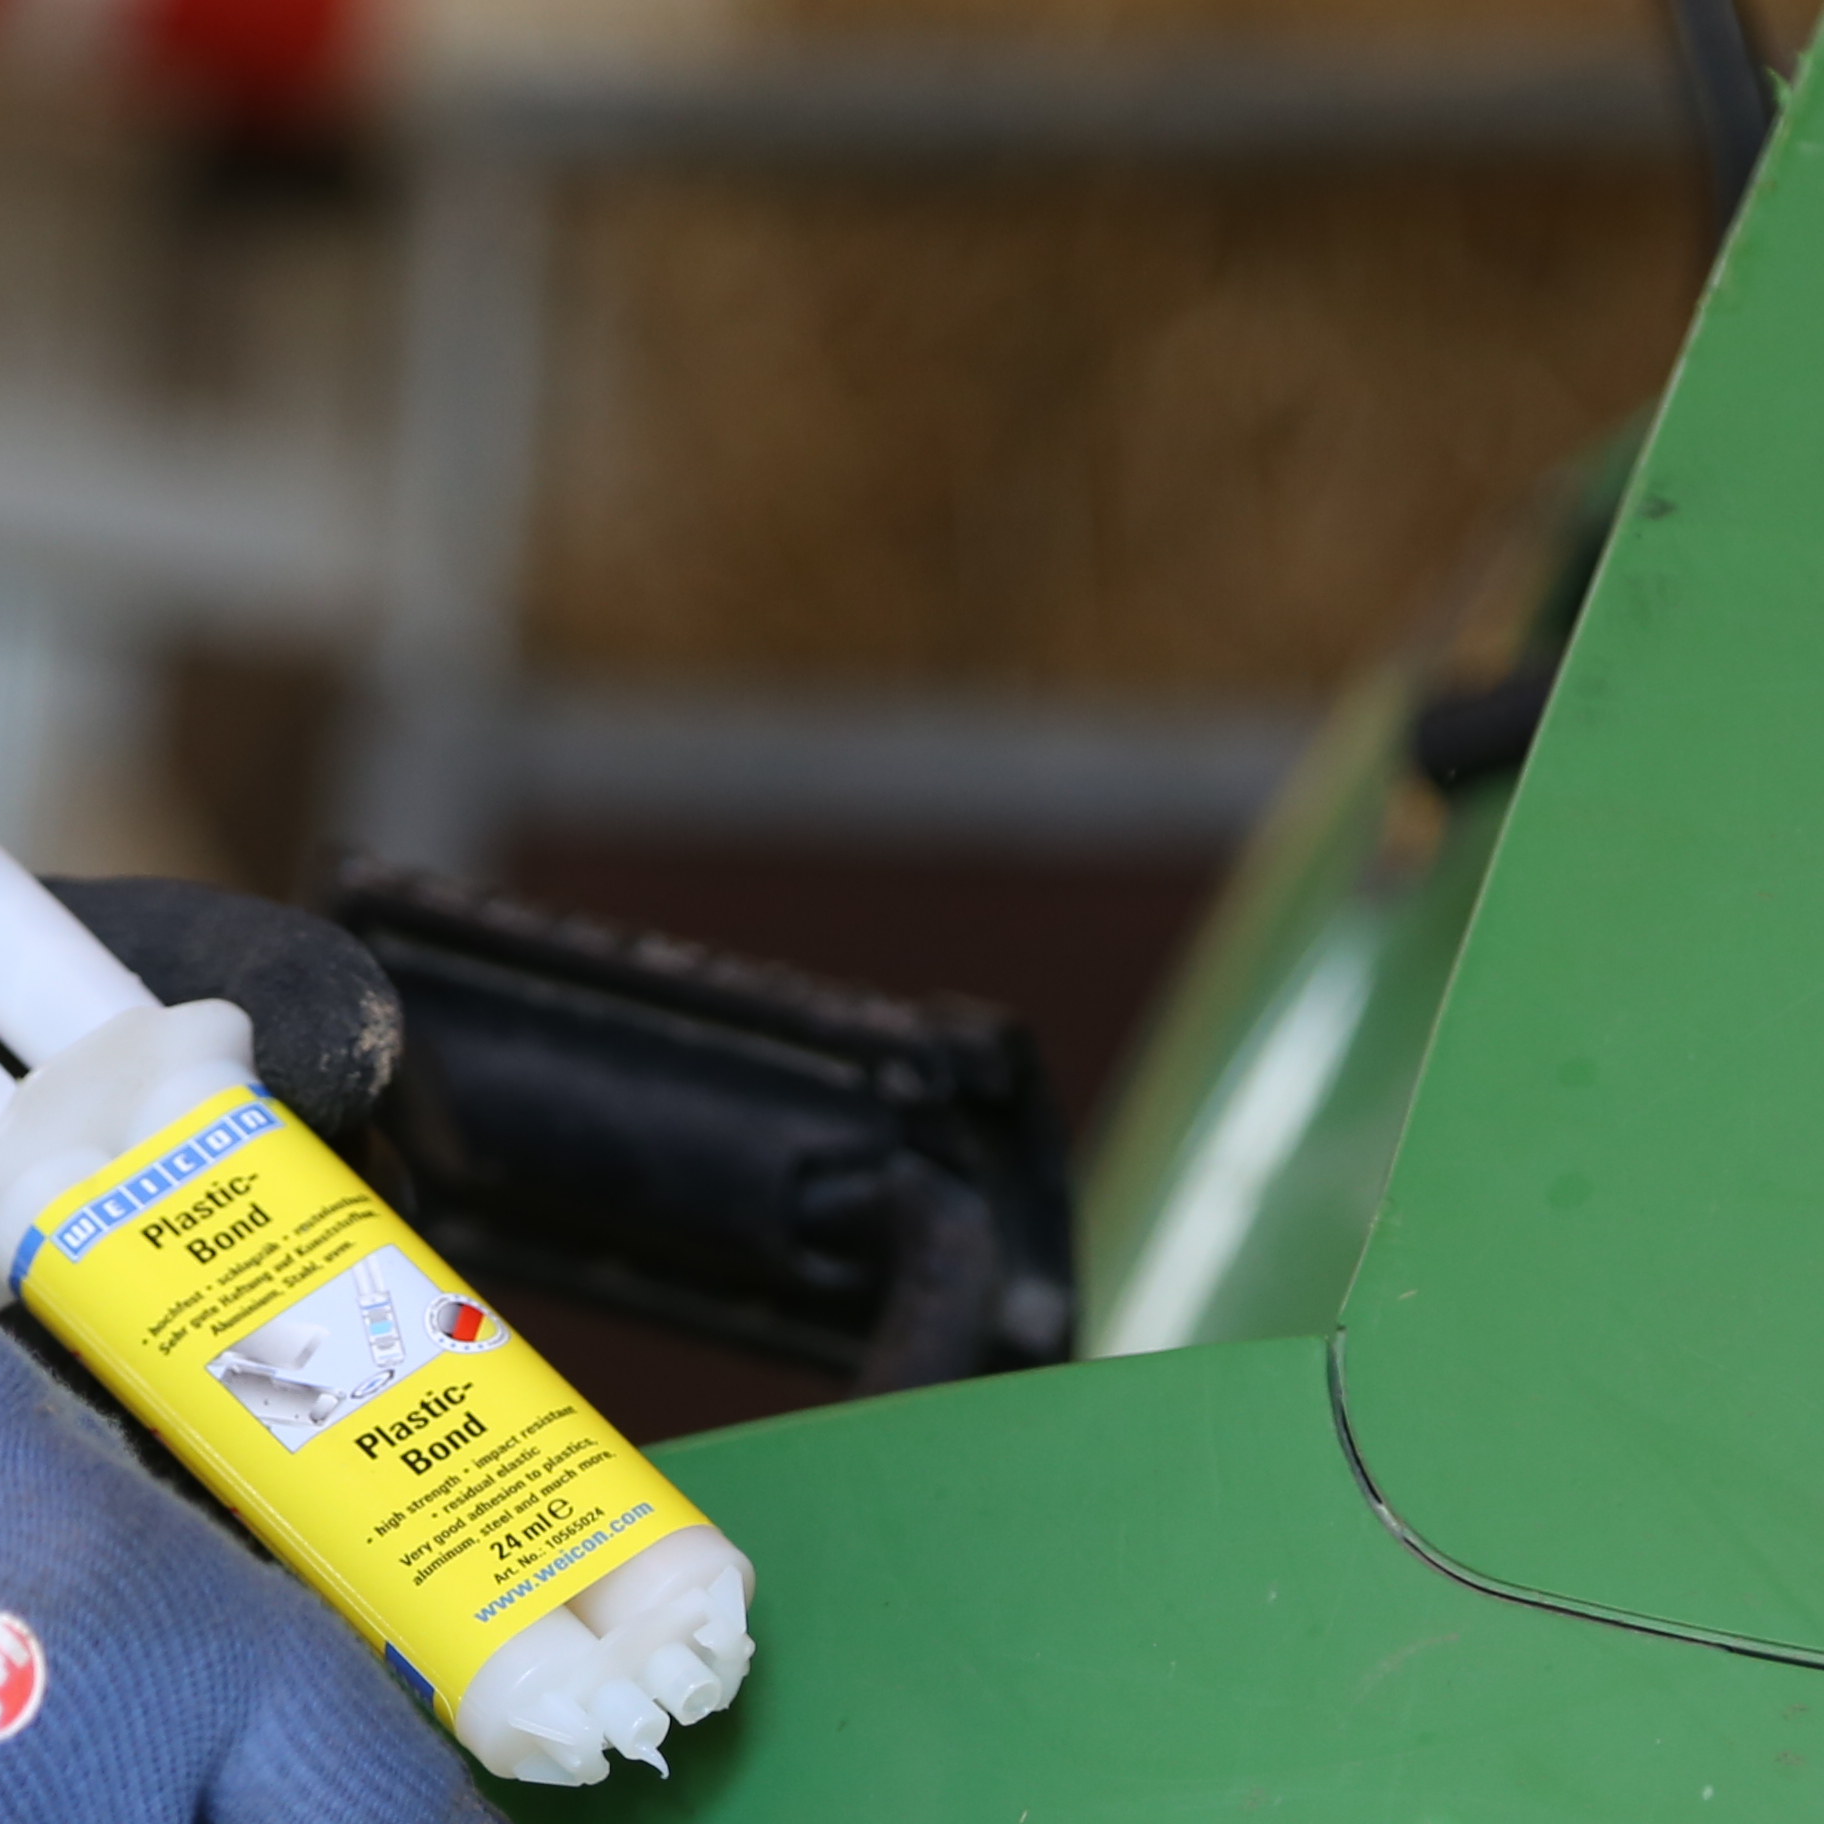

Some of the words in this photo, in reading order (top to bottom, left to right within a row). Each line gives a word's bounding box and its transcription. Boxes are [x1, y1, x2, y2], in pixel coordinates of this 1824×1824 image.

[140, 1173, 259, 1249] Plastic-
[185, 1202, 272, 1265] Bond
[159, 1324, 188, 1356] Sehr
[190, 1306, 220, 1330] gute
[217, 1270, 274, 1309] Haftung
[354, 1382, 474, 1460] Plastic-
[400, 1411, 488, 1476] Bond
[373, 1510, 406, 1539] high
[406, 1474, 462, 1515] strength
[475, 1435, 520, 1471] impact
[521, 1404, 577, 1440] resistant
[399, 1541, 433, 1569] Very
[433, 1517, 466, 1547] good
[467, 1478, 526, 1521] adhesion
[526, 1466, 542, 1481] to
[543, 1437, 599, 1474] plastics,
[442, 1475, 495, 1515] residual
[496, 1446, 541, 1479] elastic
[412, 1535, 481, 1586] aluminum,
[479, 1510, 513, 1537] steel
[514, 1492, 540, 1514] and
[541, 1468, 575, 1498] much
[577, 1449, 617, 1473] more.
[489, 1534, 523, 1561] 24
[522, 1514, 553, 1542] ml
[493, 1567, 518, 1586] Art.
[517, 1548, 547, 1569] No.:
[545, 1506, 605, 1551] 10565024
[474, 1500, 654, 1624] www.weicon.com
